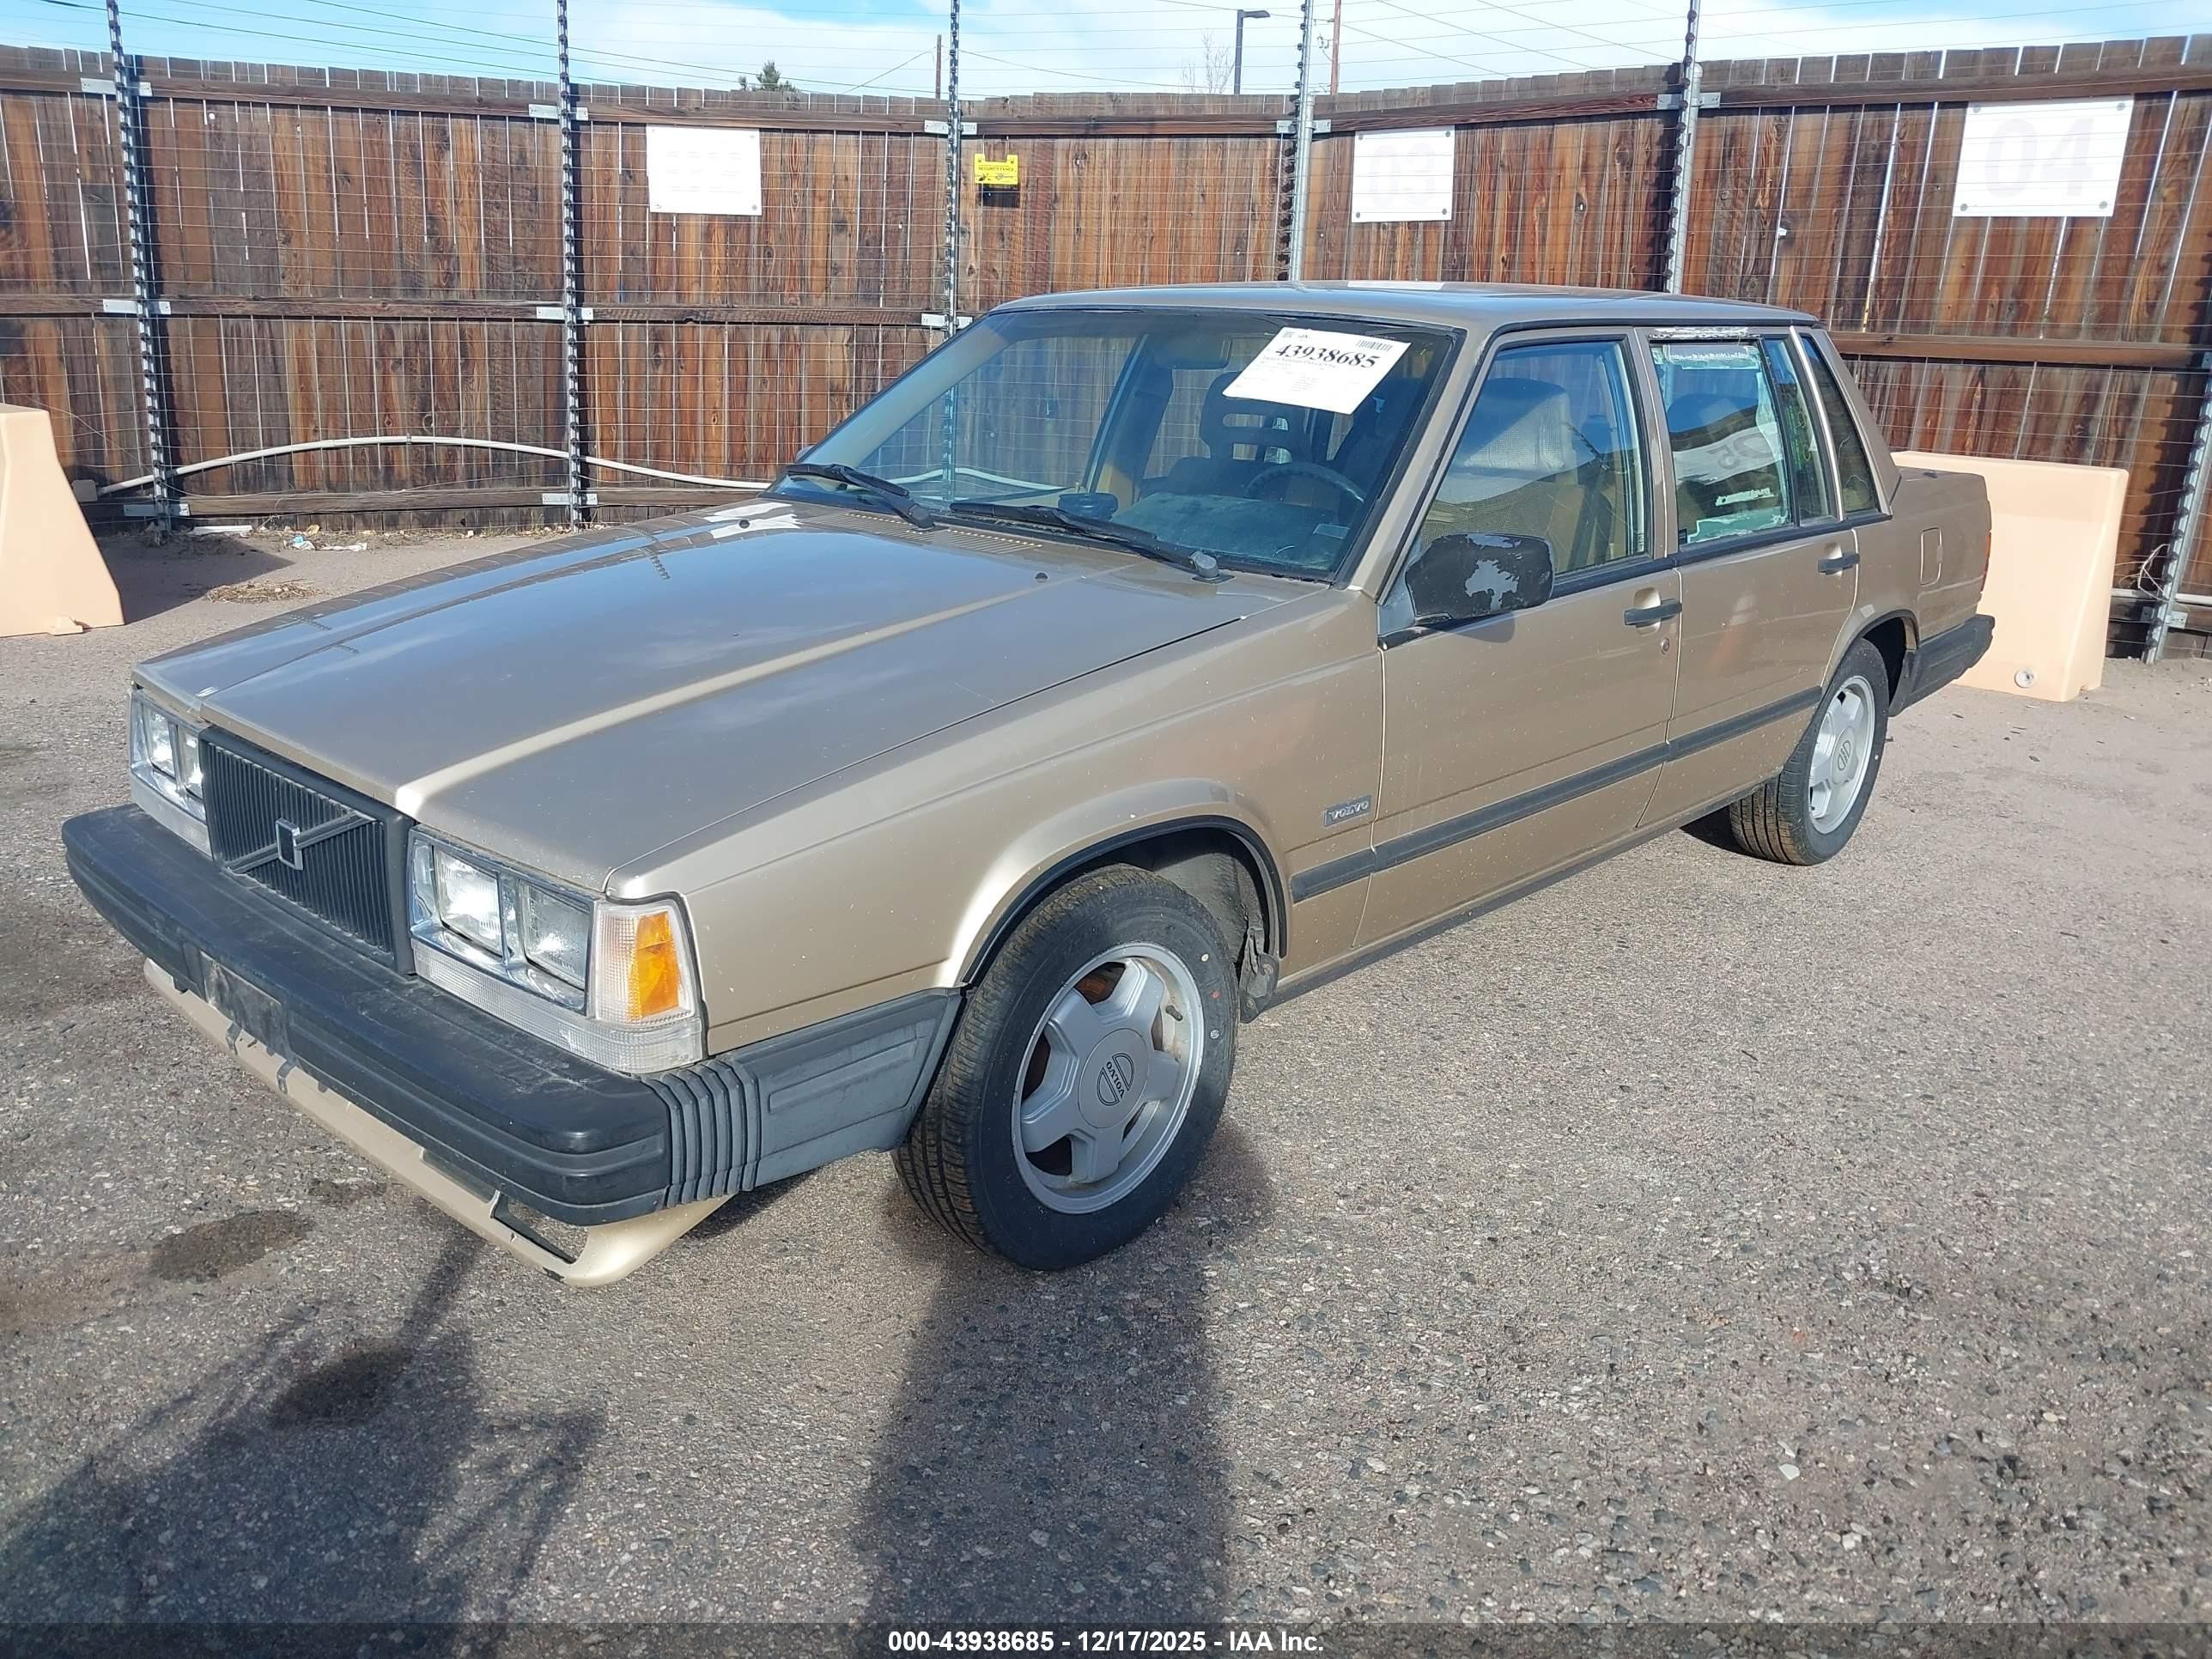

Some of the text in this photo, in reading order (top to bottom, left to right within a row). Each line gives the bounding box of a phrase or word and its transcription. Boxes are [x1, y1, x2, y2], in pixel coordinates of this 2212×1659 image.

[1369, 143, 1436, 208] 03
[1985, 118, 2095, 198] 04
[1275, 343, 1381, 368] 43938685
[1328, 800, 1369, 820] VOLVO
[1106, 1061, 1125, 1099] VOLVO
